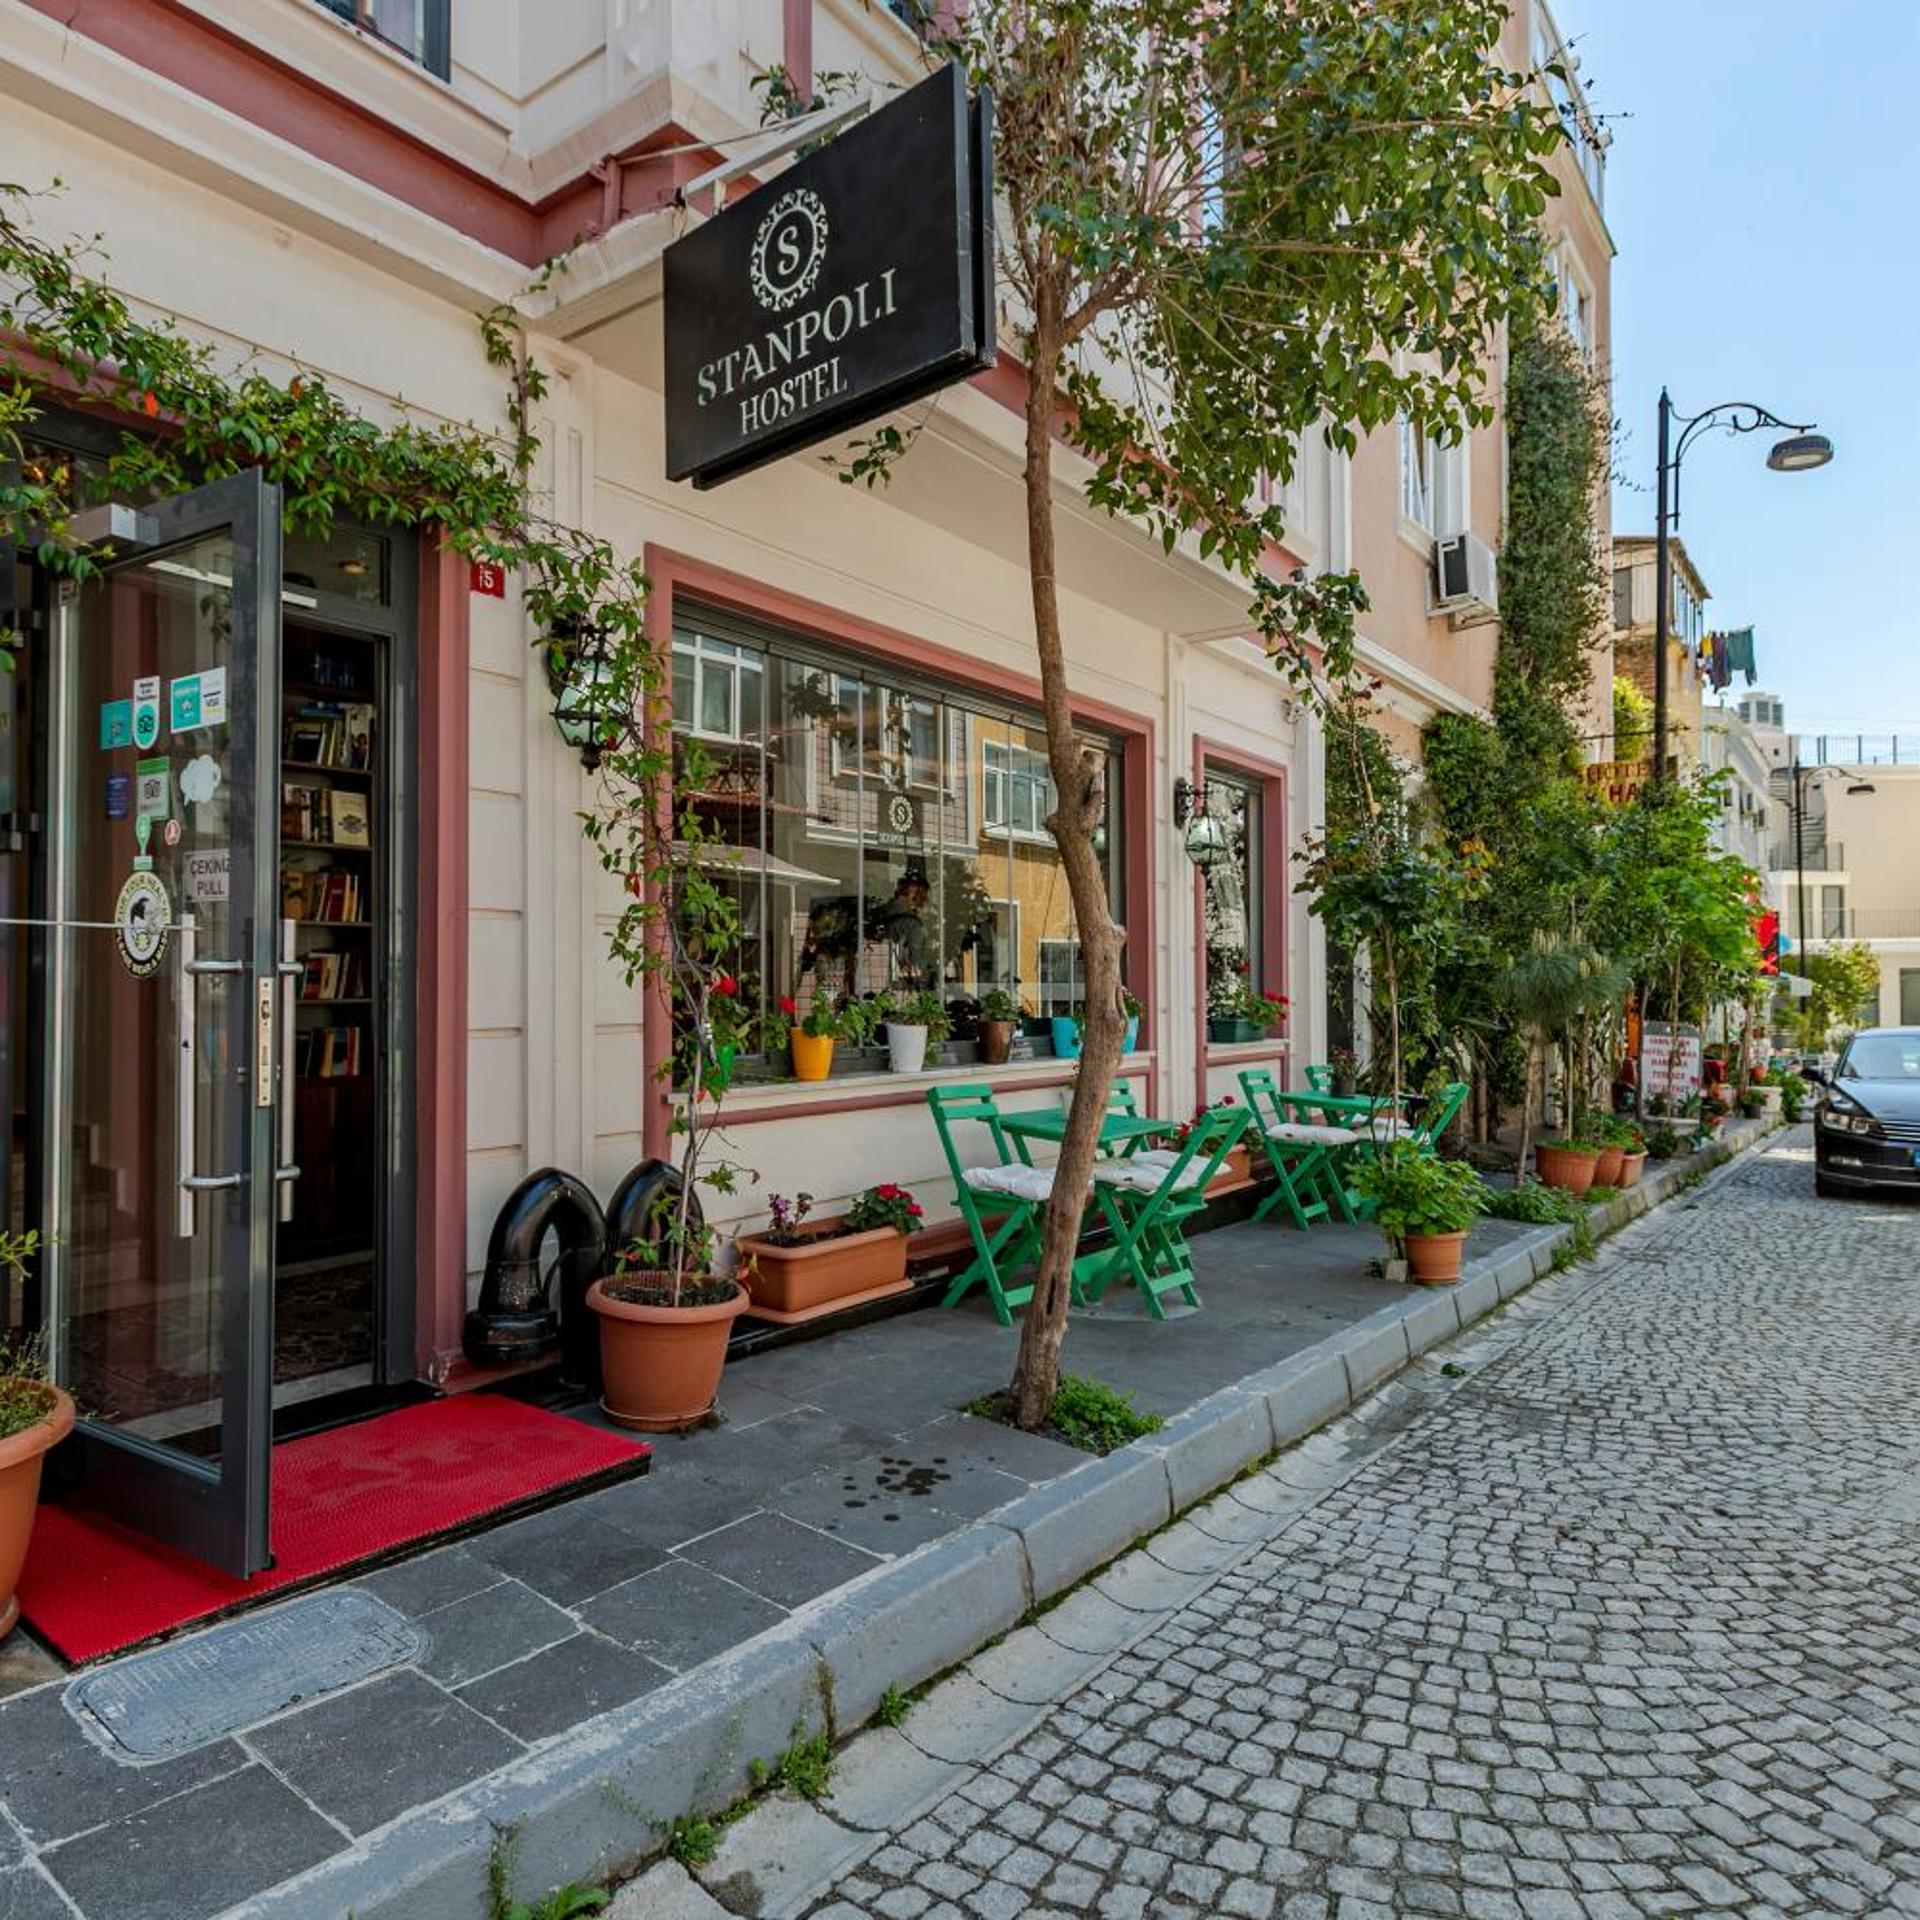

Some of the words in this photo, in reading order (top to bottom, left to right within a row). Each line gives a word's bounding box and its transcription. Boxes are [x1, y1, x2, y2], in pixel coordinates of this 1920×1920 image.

[777, 225, 799, 275] S
[698, 267, 897, 406] STANPOLI
[739, 356, 847, 435] HOSTEL
[479, 569, 495, 589] 15
[1587, 762, 1652, 780] HOTE
[197, 880, 224, 897] PULL
